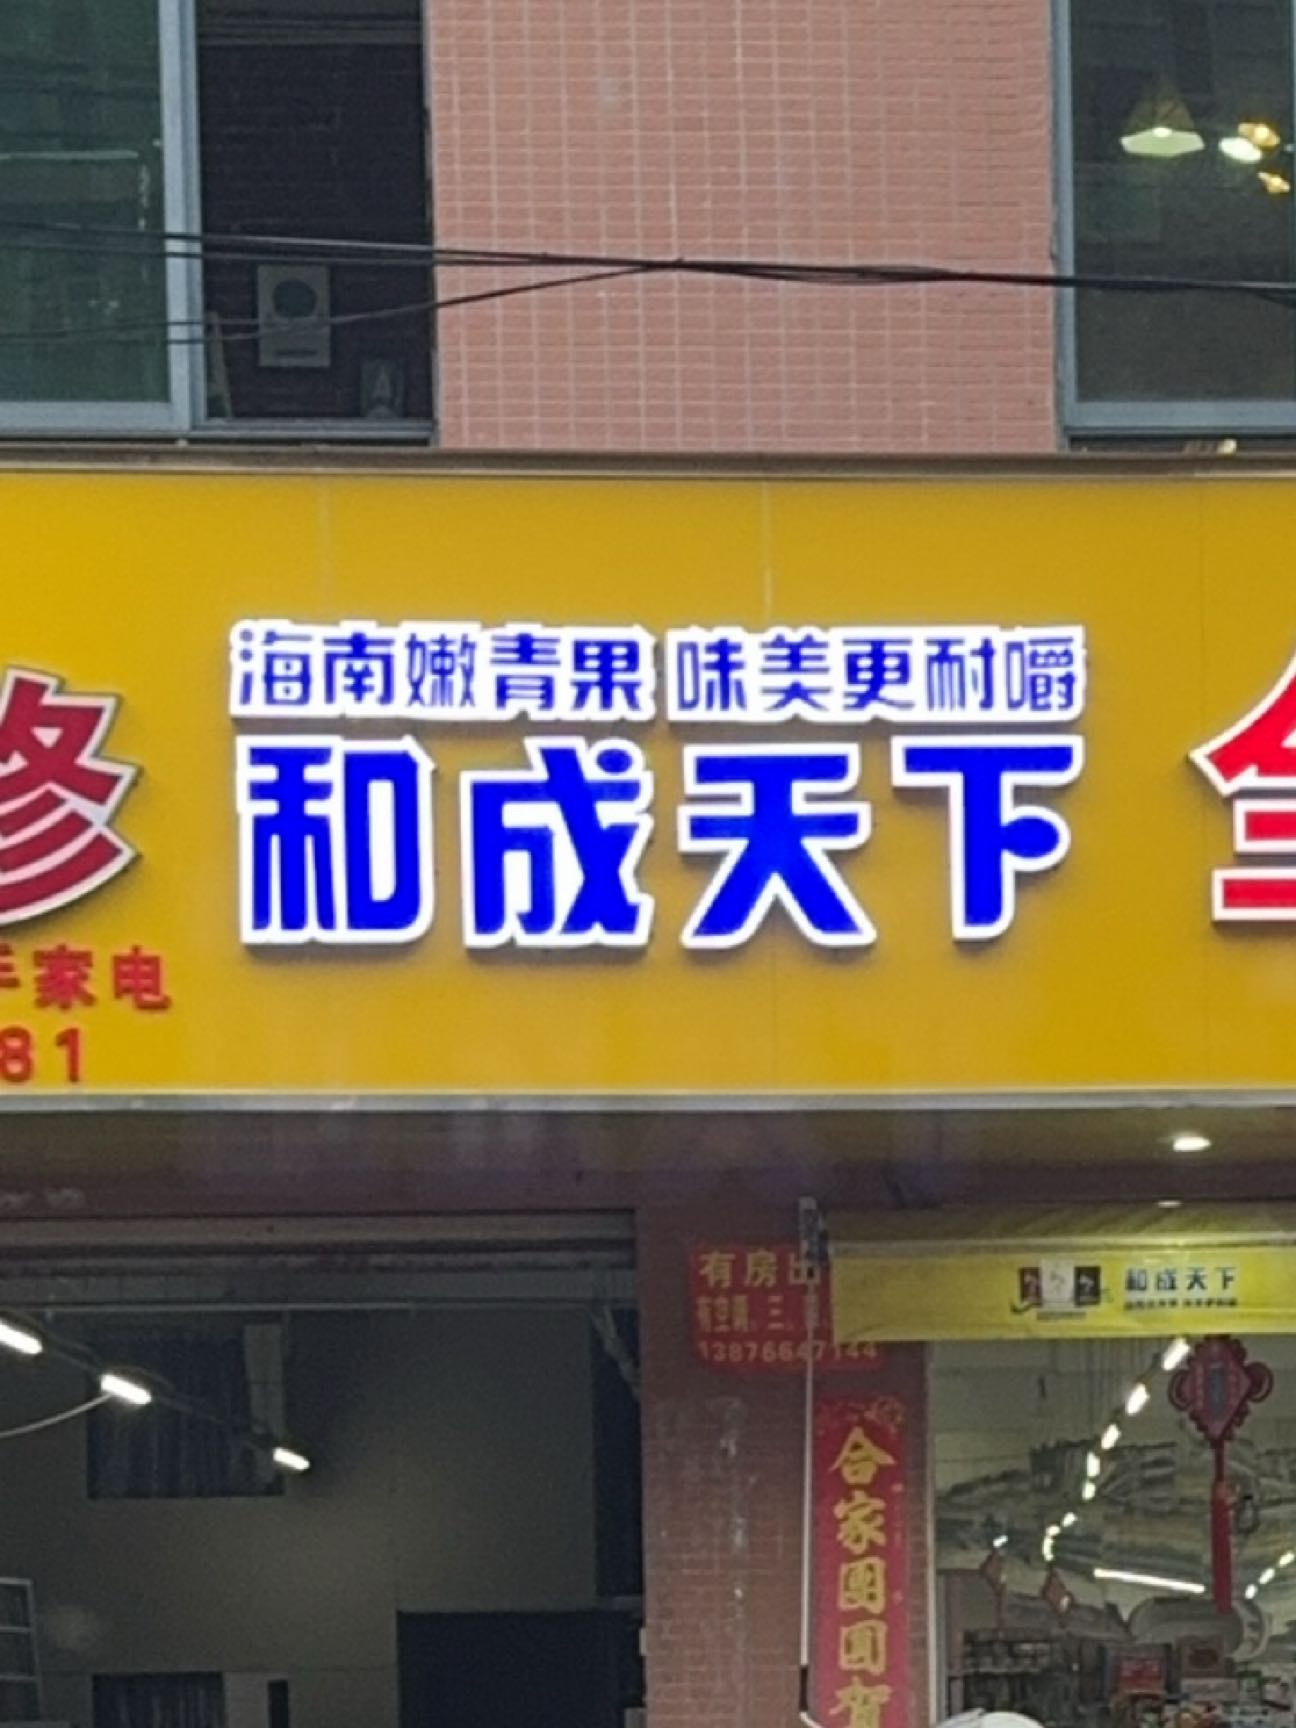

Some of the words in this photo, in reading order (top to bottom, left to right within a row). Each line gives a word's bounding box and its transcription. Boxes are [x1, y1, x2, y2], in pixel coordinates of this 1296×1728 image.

[238, 628, 643, 712] 海南嫩青果
[678, 632, 1078, 714] 味美更耐嚼
[244, 742, 1080, 940] 和成天下
